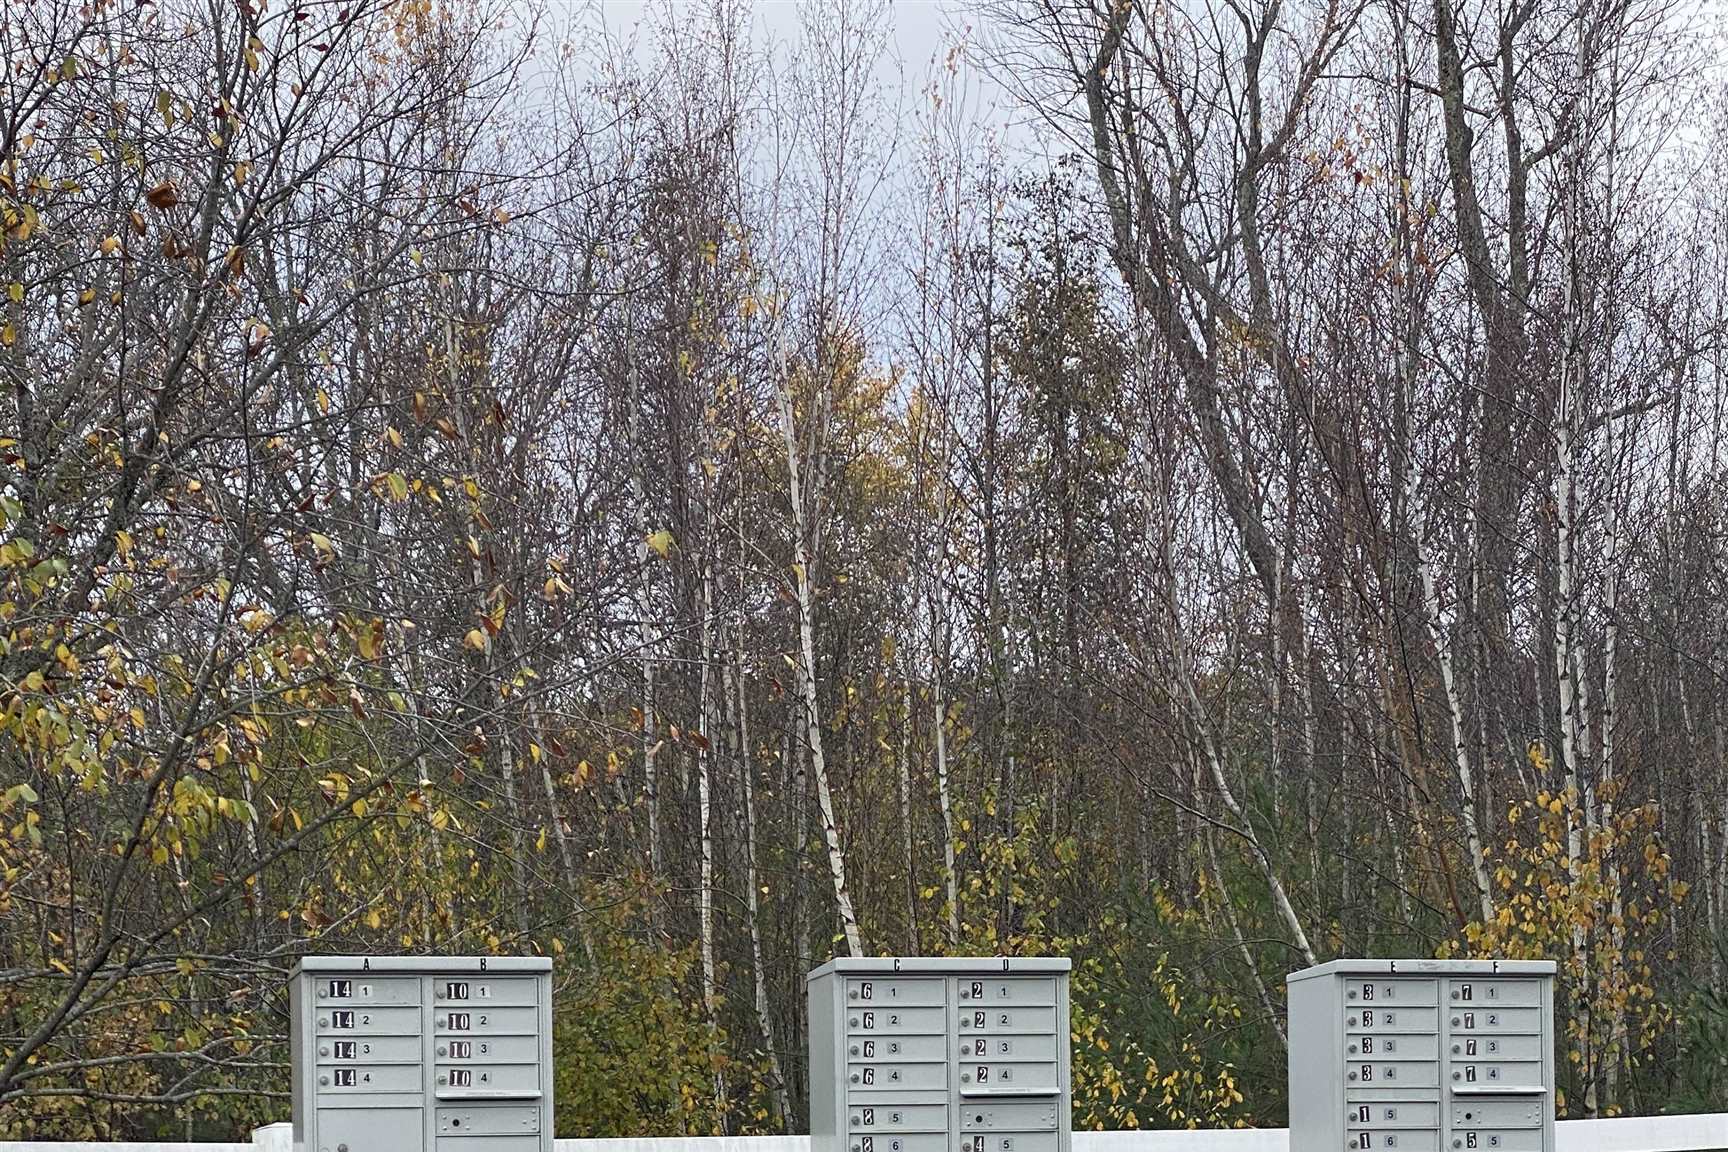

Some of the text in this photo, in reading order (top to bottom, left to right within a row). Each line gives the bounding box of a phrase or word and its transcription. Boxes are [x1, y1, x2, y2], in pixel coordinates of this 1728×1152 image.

[363, 958, 370, 972] A
[480, 958, 487, 971] B
[894, 959, 900, 971] C
[1003, 959, 1009, 971] D
[1390, 961, 1396, 973] E
[1493, 961, 1499, 973] F
[332, 981, 368, 997] 14 1
[449, 983, 485, 999] 10 1
[863, 983, 896, 999] 6 1
[973, 983, 1006, 998] 2 1
[1365, 985, 1391, 1000] 3 1
[1463, 985, 1494, 1000] 7 1
[335, 1012, 369, 1028] 14 2
[450, 1014, 487, 1030] 10 2
[865, 1013, 897, 1028] 6 2
[975, 1012, 1008, 1028] 2 2
[1364, 1011, 1393, 1027] 3 2
[1465, 1013, 1496, 1028] 7 2
[337, 1042, 370, 1058] 14 3
[452, 1042, 487, 1058] 10 3
[865, 1041, 897, 1057] 6 3
[976, 1040, 1008, 1056] 2 3
[1363, 1038, 1393, 1053] 3 3
[1467, 1040, 1496, 1055] 7 3
[337, 1070, 371, 1086] 14 4
[452, 1070, 487, 1086] 10 4
[865, 1069, 898, 1084] 6 4
[978, 1067, 1008, 1083] 2 4
[1363, 1065, 1393, 1081] 3 4
[1467, 1066, 1496, 1081] 7 4
[865, 1109, 899, 1124] 8 5
[1361, 1106, 1394, 1122] 1 5
[863, 1137, 899, 1152] 8 6
[975, 1136, 1010, 1151] 4 5
[1362, 1133, 1394, 1149] 1 6
[1467, 1132, 1497, 1148] 5 5
